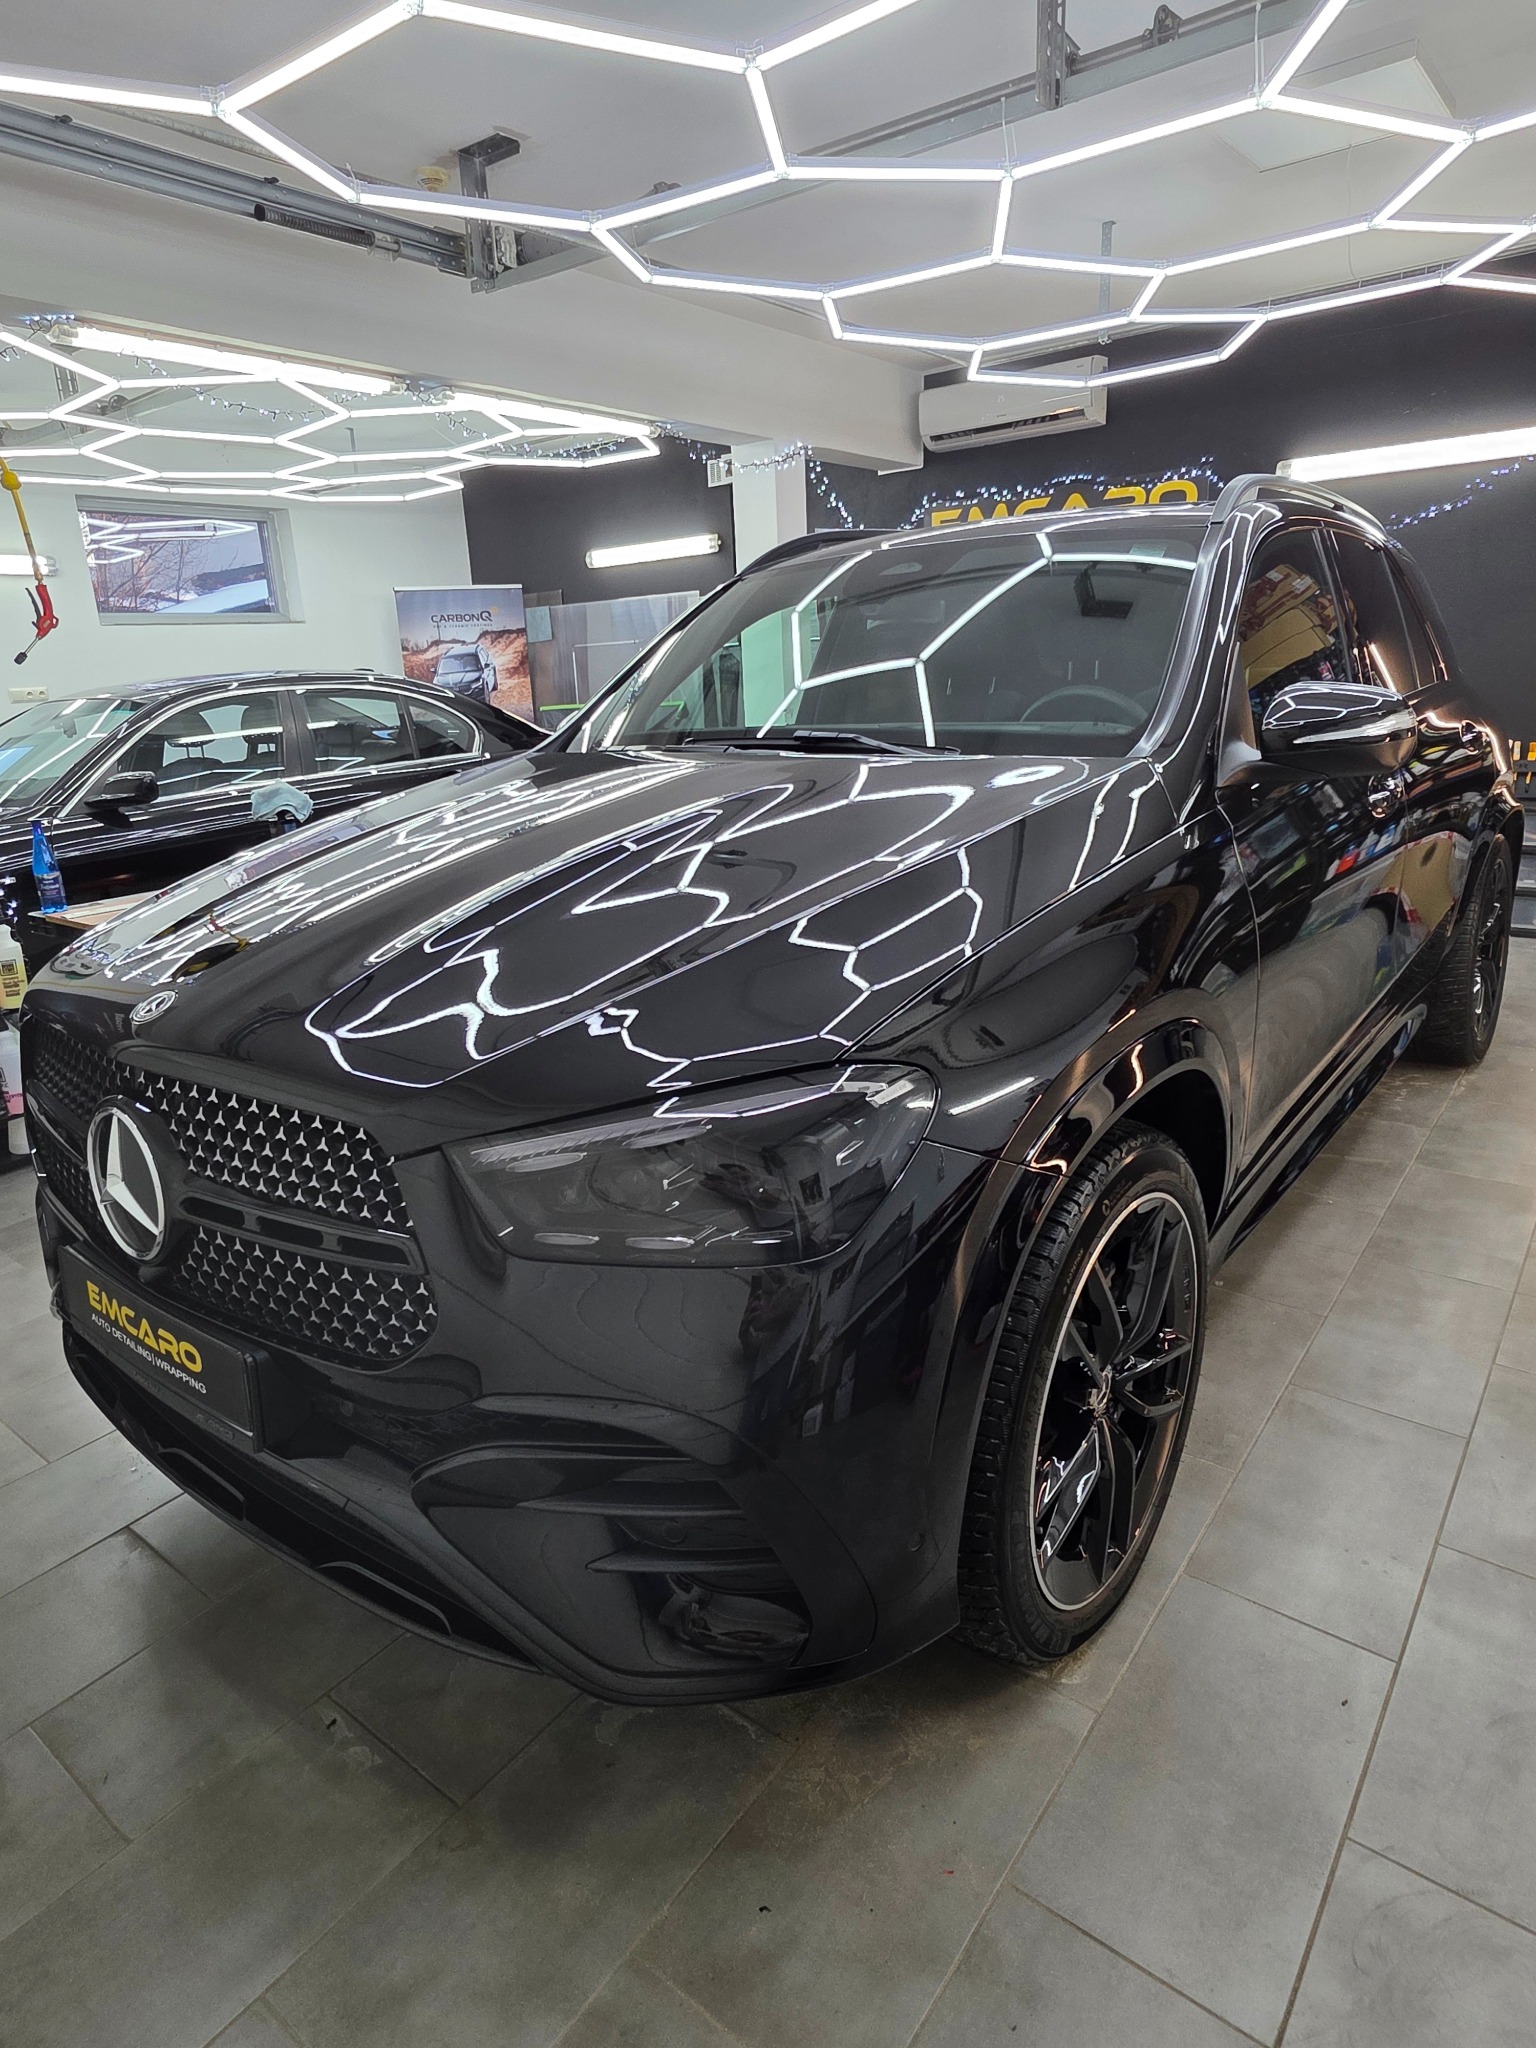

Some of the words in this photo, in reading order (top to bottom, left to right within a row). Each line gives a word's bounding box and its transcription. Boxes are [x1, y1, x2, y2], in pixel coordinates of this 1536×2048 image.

[431, 610, 493, 623] CARBONQ
[86, 1280, 202, 1373] EMCARO
[92, 1313, 111, 1333] AUTO
